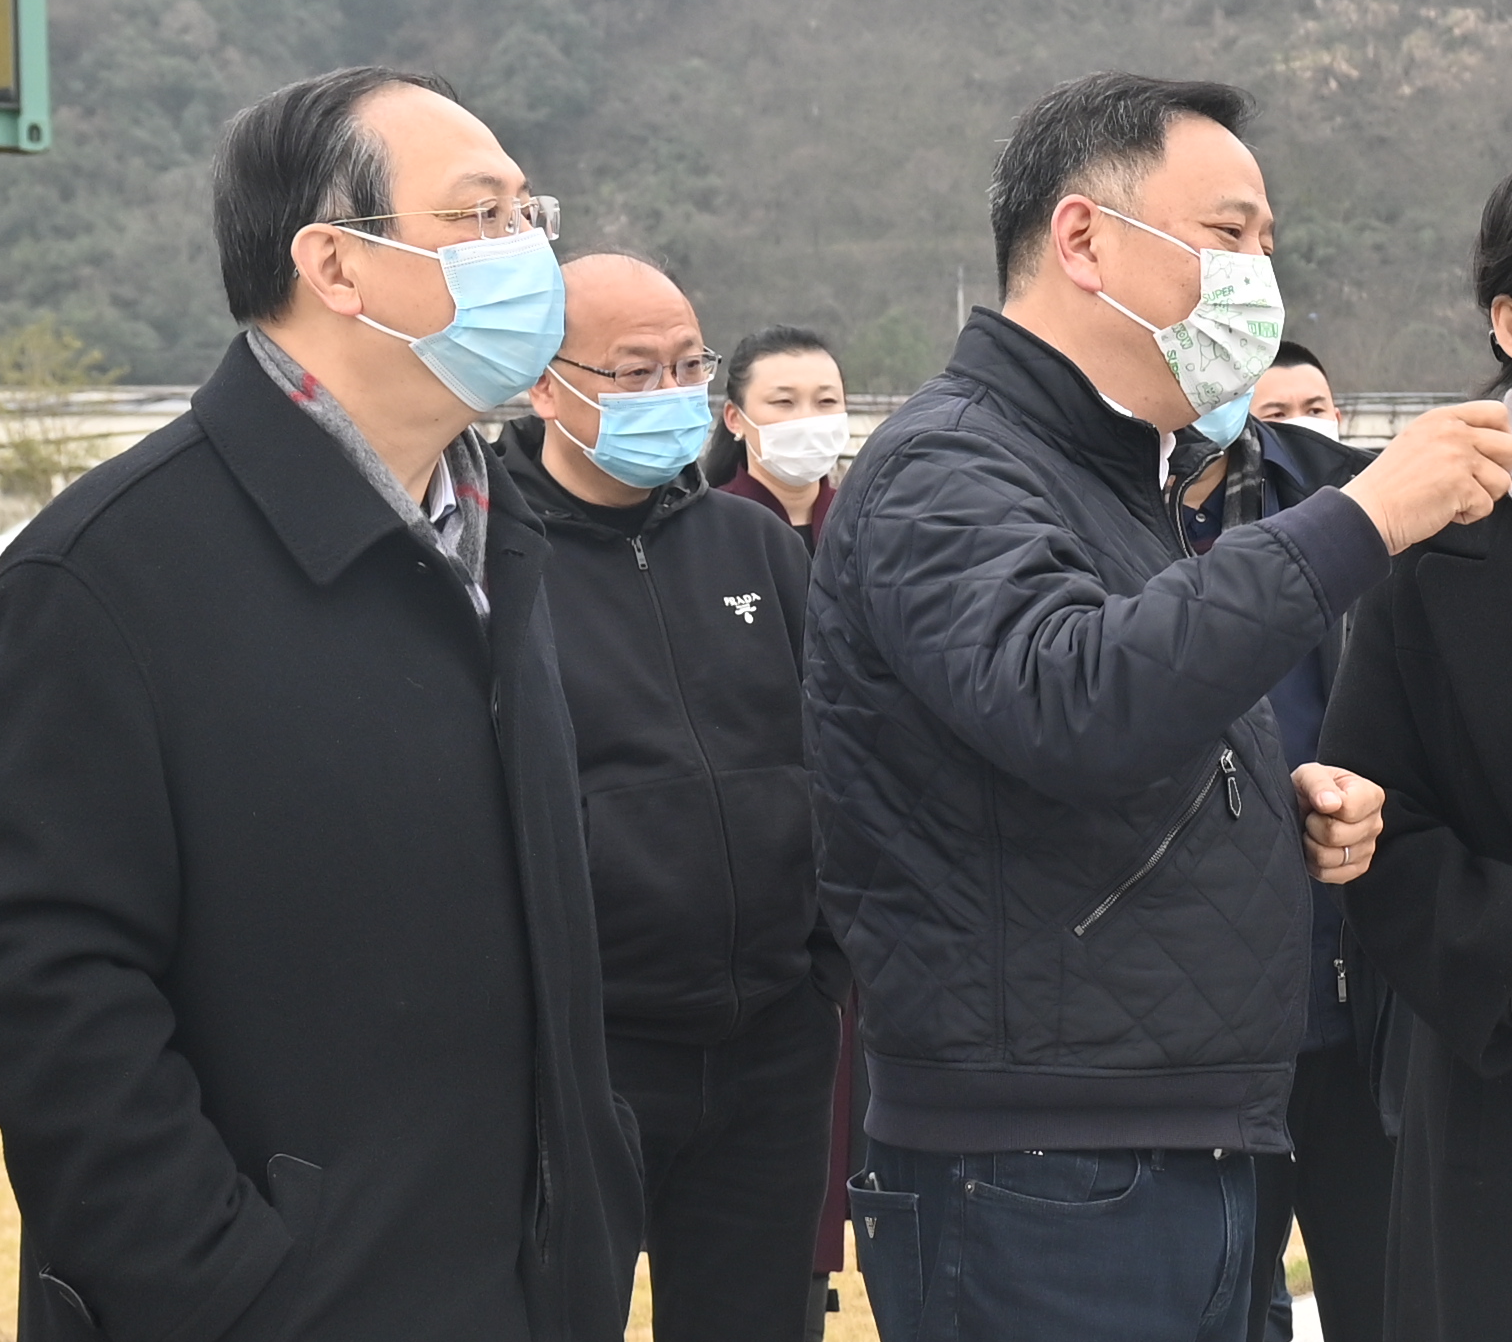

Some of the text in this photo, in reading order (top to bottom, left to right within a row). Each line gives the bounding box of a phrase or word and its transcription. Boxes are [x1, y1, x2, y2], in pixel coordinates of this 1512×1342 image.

[1202, 285, 1235, 304] SUPER
[1172, 322, 1194, 350] WOW
[723, 592, 762, 607] PRADA
